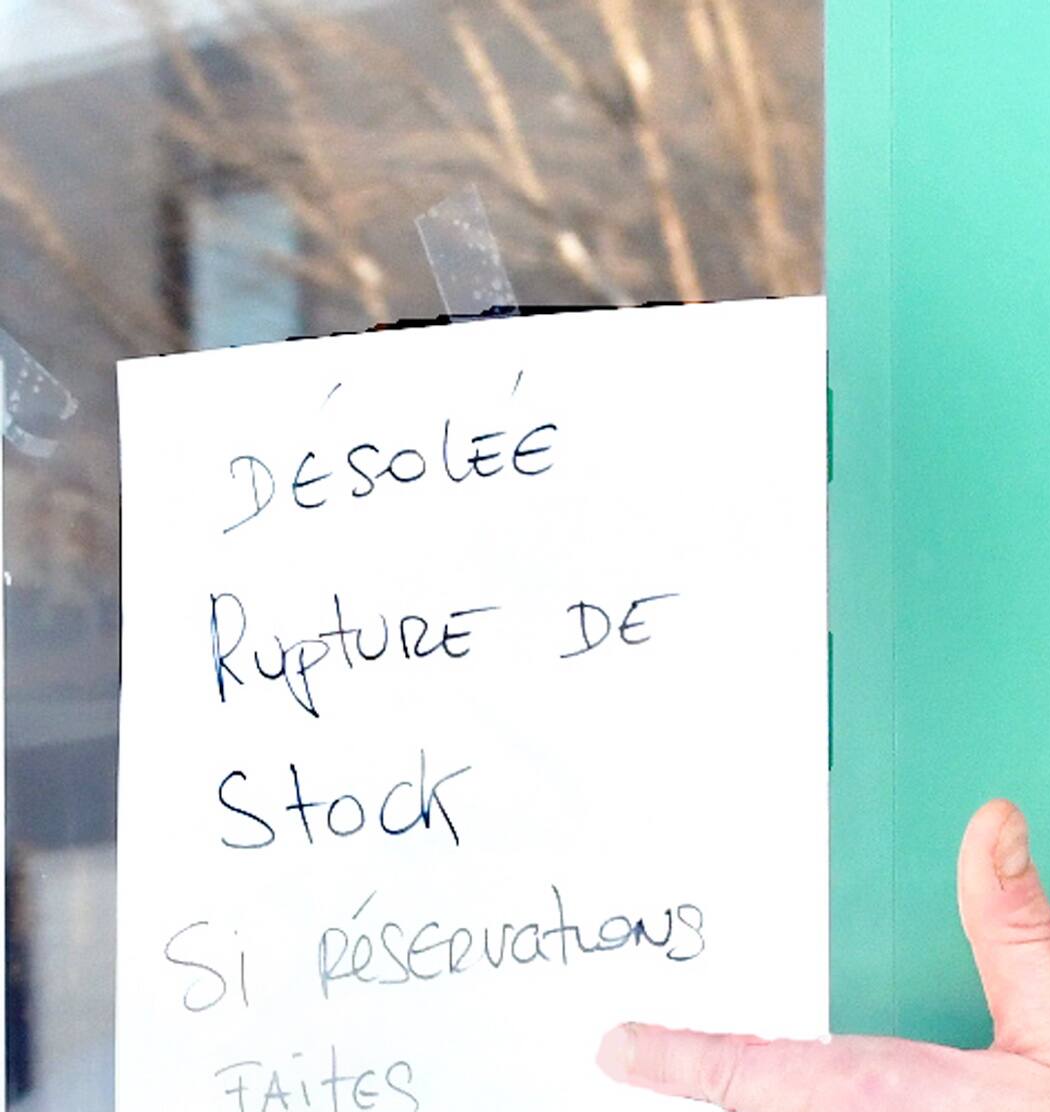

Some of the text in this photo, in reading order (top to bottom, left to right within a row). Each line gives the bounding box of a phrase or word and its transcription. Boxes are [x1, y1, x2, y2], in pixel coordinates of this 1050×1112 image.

[559, 592, 681, 659] DE
[217, 748, 473, 850] Stock
[163, 919, 249, 1013] Si
